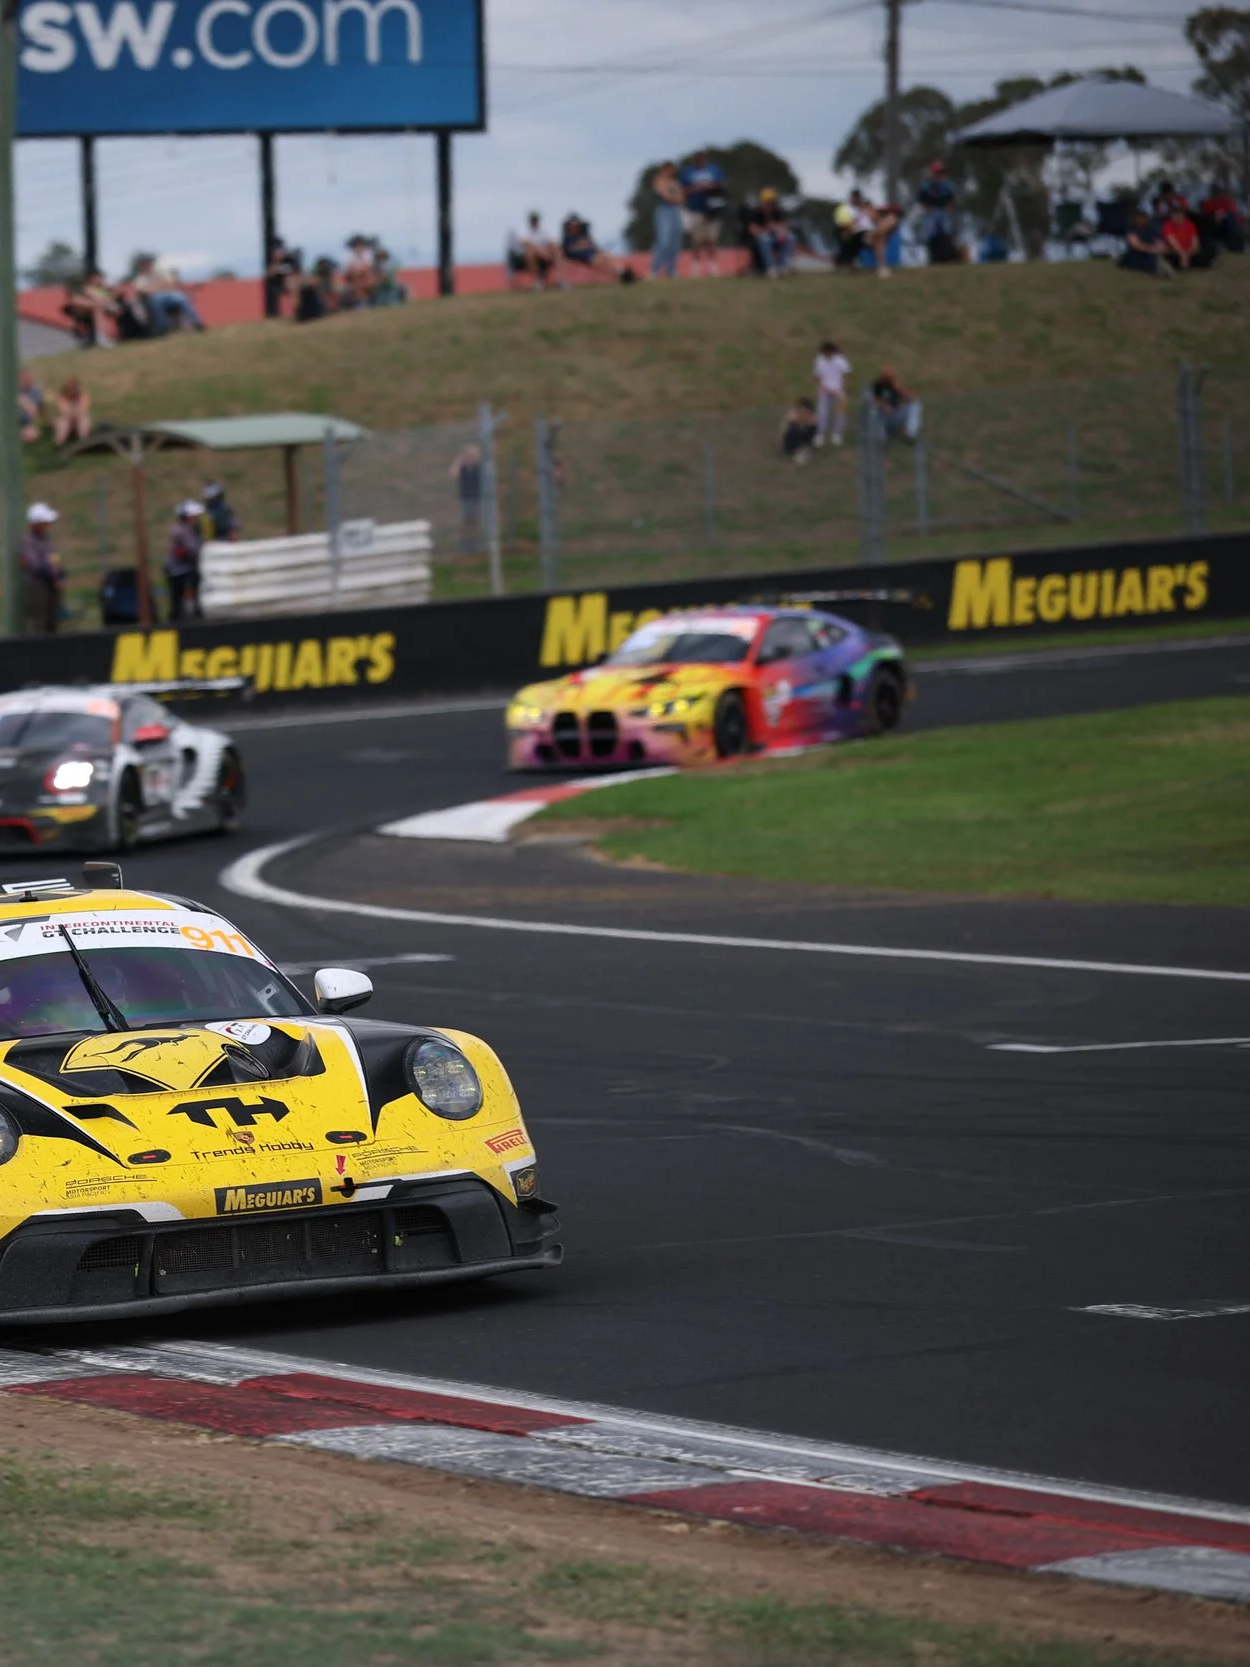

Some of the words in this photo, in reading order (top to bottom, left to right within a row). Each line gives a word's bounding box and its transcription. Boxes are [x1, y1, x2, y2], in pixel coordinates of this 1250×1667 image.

[949, 557, 1209, 630] MEGUIAR'S
[40, 920, 179, 931] INTERCONTINENTAL
[71, 926, 181, 935] CHALLENGE
[180, 925, 255, 957] 911
[191, 1145, 255, 1160] Trends
[259, 1141, 315, 1153] Hobby
[351, 1145, 419, 1158] PORSCHE
[65, 1174, 147, 1187] PORSCHE
[65, 1184, 111, 1195] MOTORSPORT
[224, 1187, 316, 1211] MEGUIAR'S
